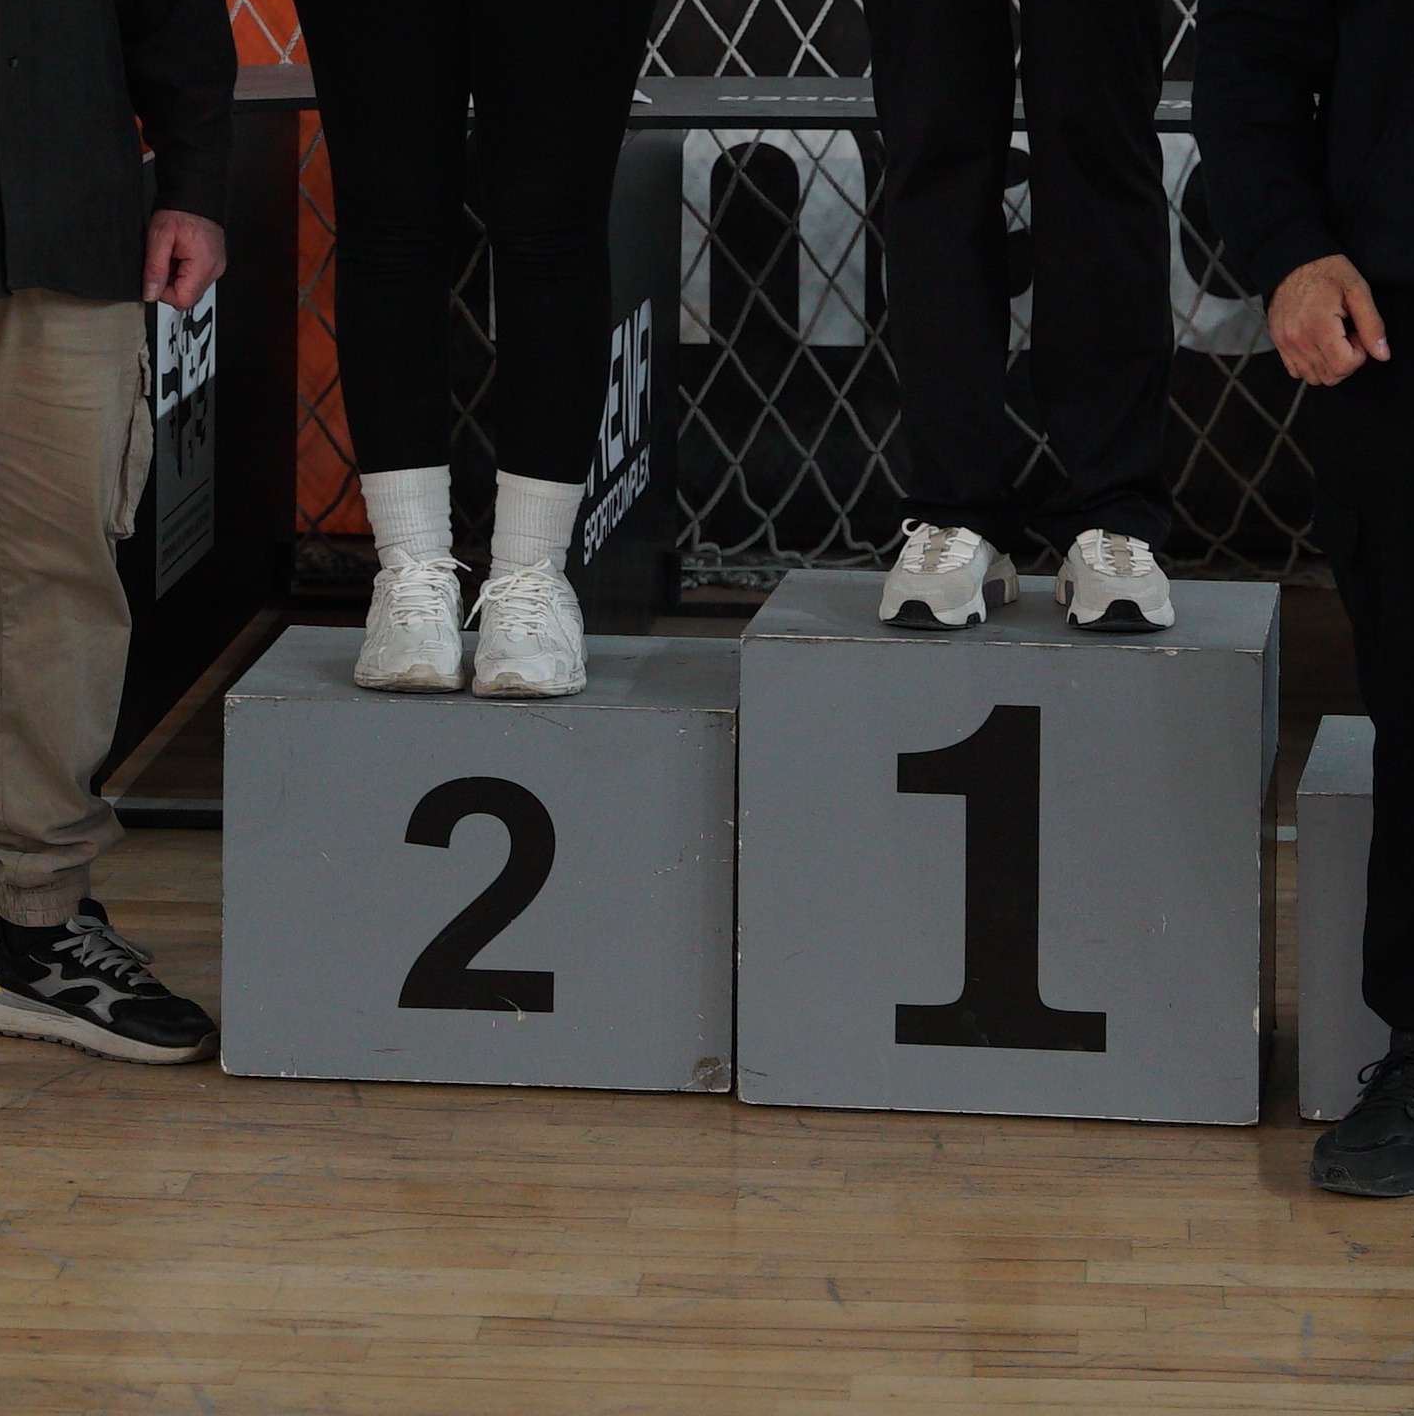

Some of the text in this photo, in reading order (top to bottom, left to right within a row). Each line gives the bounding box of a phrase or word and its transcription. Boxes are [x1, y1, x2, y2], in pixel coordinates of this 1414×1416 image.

[583, 443, 651, 566] SPORTCOMPLEX
[397, 776, 556, 1012] 2
[892, 705, 1107, 1052] 1
